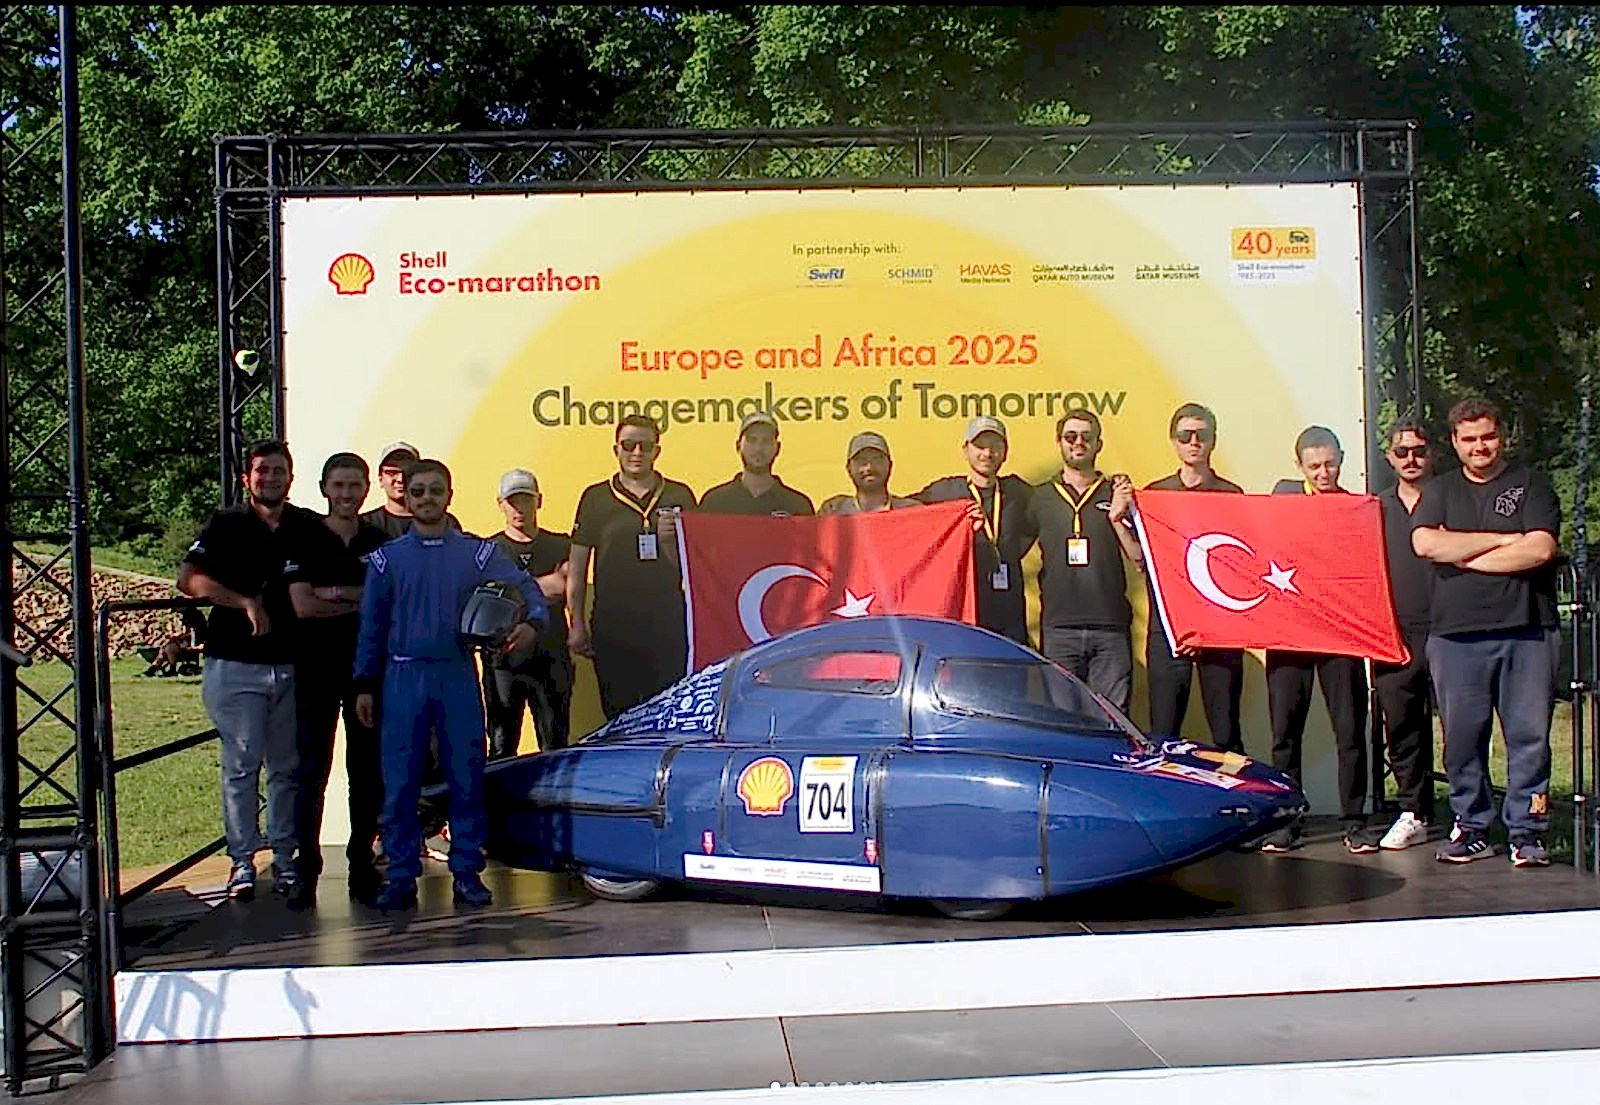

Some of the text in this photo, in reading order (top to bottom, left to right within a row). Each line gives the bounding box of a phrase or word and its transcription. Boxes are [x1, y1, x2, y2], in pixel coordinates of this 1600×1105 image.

[792, 245, 803, 255] In
[806, 243, 871, 258] partnership
[1237, 231, 1311, 257] 40 years
[399, 251, 447, 268] Shell
[960, 264, 1012, 276] HAVAS
[399, 268, 600, 294] Eco-marathon
[808, 268, 845, 280] SwRI
[888, 268, 934, 279] SCHMID
[620, 332, 1039, 380] Europe and Africa 2025
[532, 378, 1127, 434] Changemakers of Tomorrow
[806, 782, 847, 820] 704
